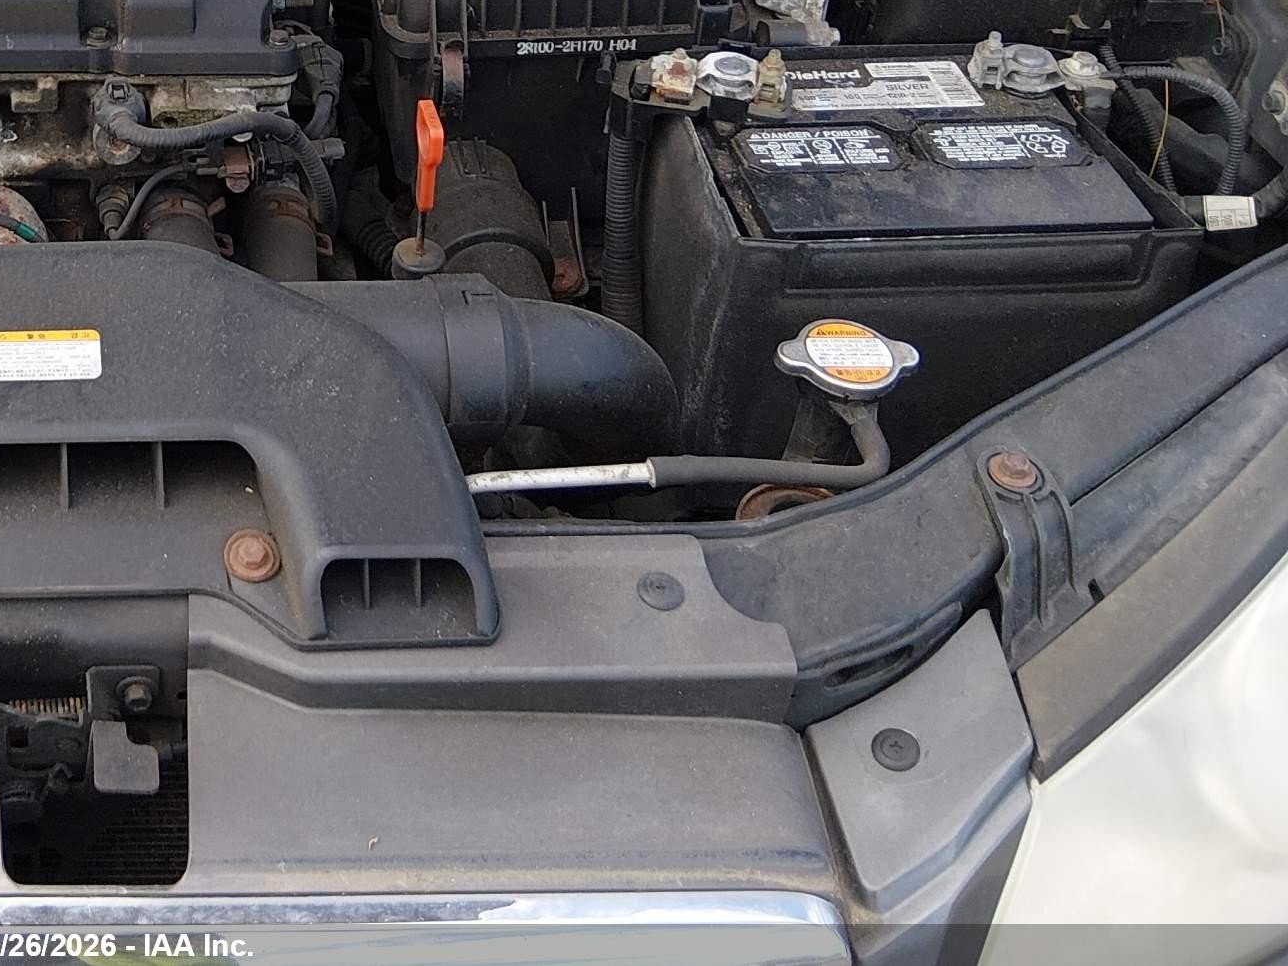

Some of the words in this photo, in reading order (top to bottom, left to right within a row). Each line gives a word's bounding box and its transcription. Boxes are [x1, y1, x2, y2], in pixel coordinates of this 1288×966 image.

[516, 40, 604, 55] 28100-2H170
[785, 69, 862, 80] DieHard
[885, 83, 929, 91] SILVER
[760, 131, 811, 140] DANGER
[823, 129, 868, 138] POISON
